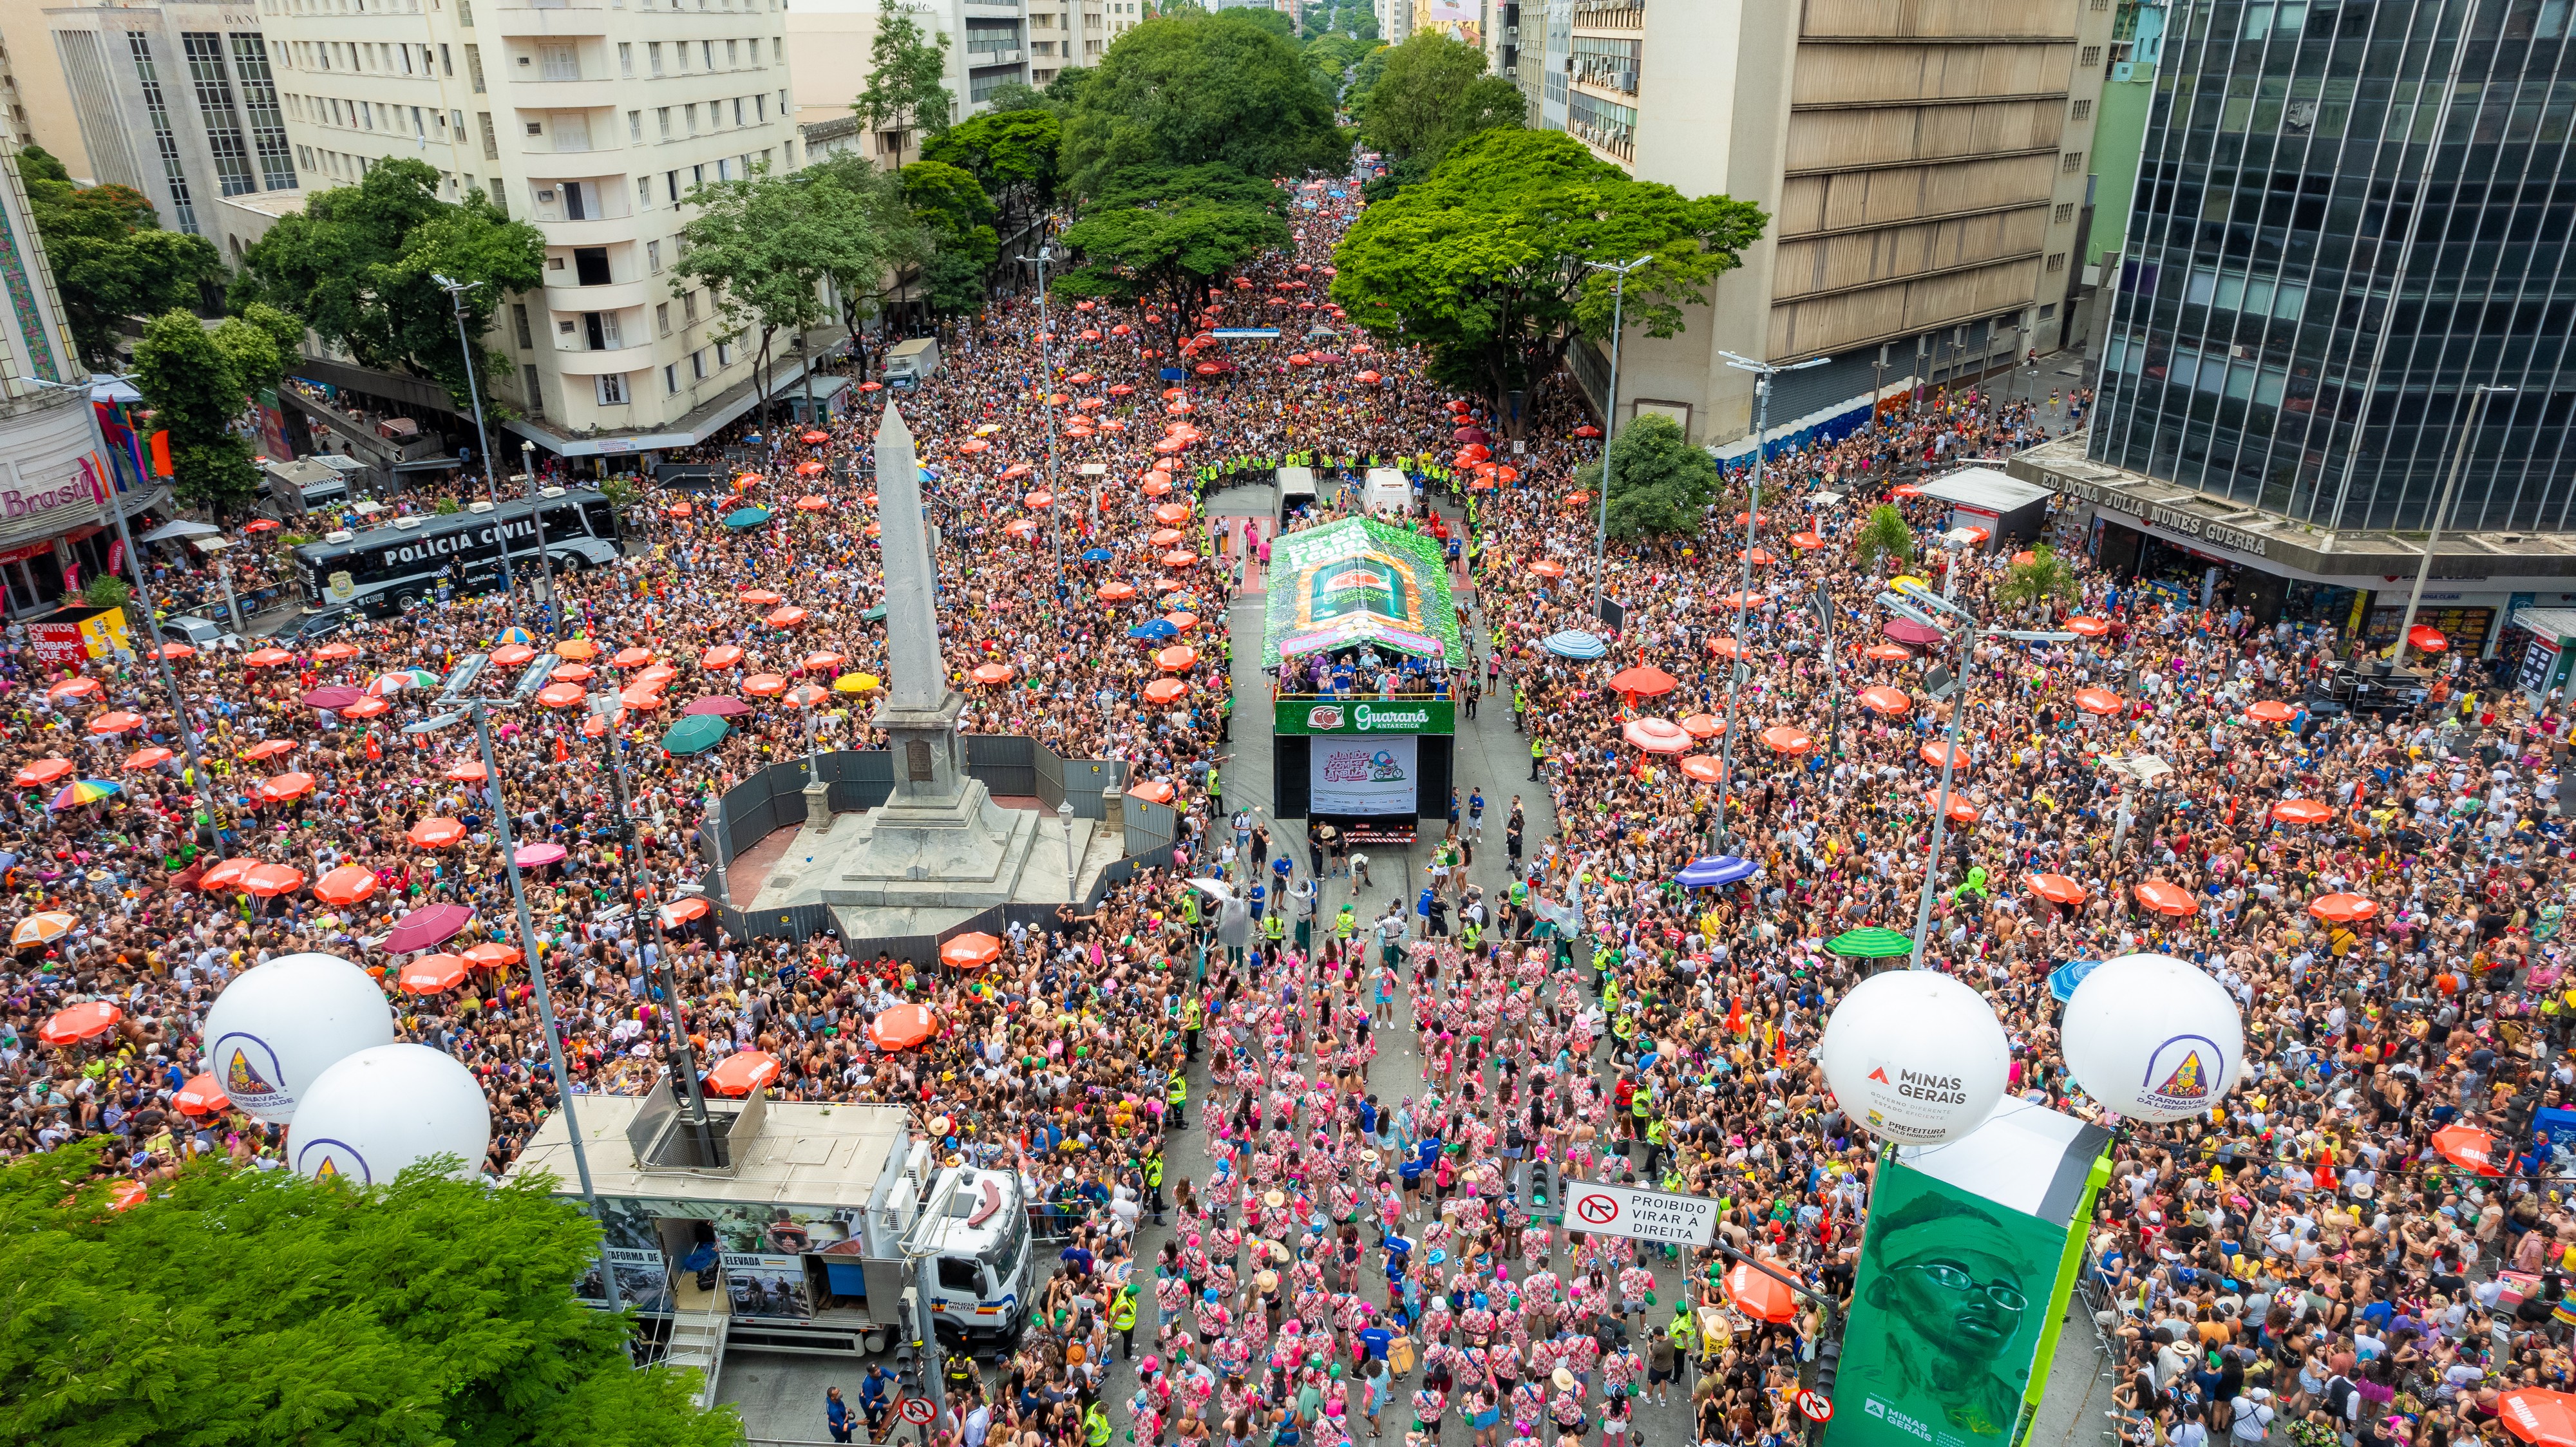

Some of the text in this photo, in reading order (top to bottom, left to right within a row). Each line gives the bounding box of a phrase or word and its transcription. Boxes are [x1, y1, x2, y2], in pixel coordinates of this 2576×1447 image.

[1, 470, 91, 518] Brasil
[2041, 472, 2061, 491] ED.
[2064, 479, 2100, 503] DONA
[2105, 492, 2145, 518] JULIA
[2150, 506, 2202, 534] NUNES
[2205, 524, 2267, 556] GUERRA
[384, 520, 536, 565] POLÍCIA CIVIL
[309, 569, 319, 598] DEPTUR
[26, 623, 75, 633] PONTOS
[32, 632, 46, 641] DE
[33, 641, 78, 651] EMBAR-
[37, 650, 61, 661] QUE
[1354, 704, 1429, 730] Guaraná
[424, 831, 450, 841] BRAHMA
[213, 868, 241, 881] BRAHMA
[247, 877, 274, 890] BRAHMA
[951, 948, 978, 960] BRAHMA
[409, 974, 437, 986] BRAHMA
[1900, 1068, 1962, 1091] MINAS
[176, 1092, 204, 1106] BRAHMA
[229, 1093, 284, 1102] CARNAVAL
[1898, 1084, 1967, 1104] GERAIS
[2147, 1094, 2206, 1106] CARNAVAL
[240, 1097, 294, 1108] LIBERDADE
[1871, 1092, 1953, 1115] GOVERNO DIFERENTE.
[2137, 1097, 2210, 1110] DA LIBERDADE
[1874, 1099, 1946, 1121] ESTADO EFICIENTE.
[1888, 1121, 1946, 1135] PREFEITURA
[1888, 1127, 1906, 1135] BELO
[2461, 1148, 2488, 1164] BRAH
[1631, 1195, 1707, 1214] PROIBIDO
[1633, 1209, 1699, 1227] VIRAR À
[1633, 1224, 1693, 1240] DIREITA
[647, 1252, 659, 1262] DE
[725, 1256, 761, 1267] ELEVADA
[1870, 1392, 1895, 1405] REALIZAÇÃO
[2507, 1395, 2540, 1430] BRAHMA
[1888, 1408, 1928, 1432] MINAS
[1887, 1417, 1932, 1442] GERAIS
[1938, 1431, 1965, 1444] GOVERNO
